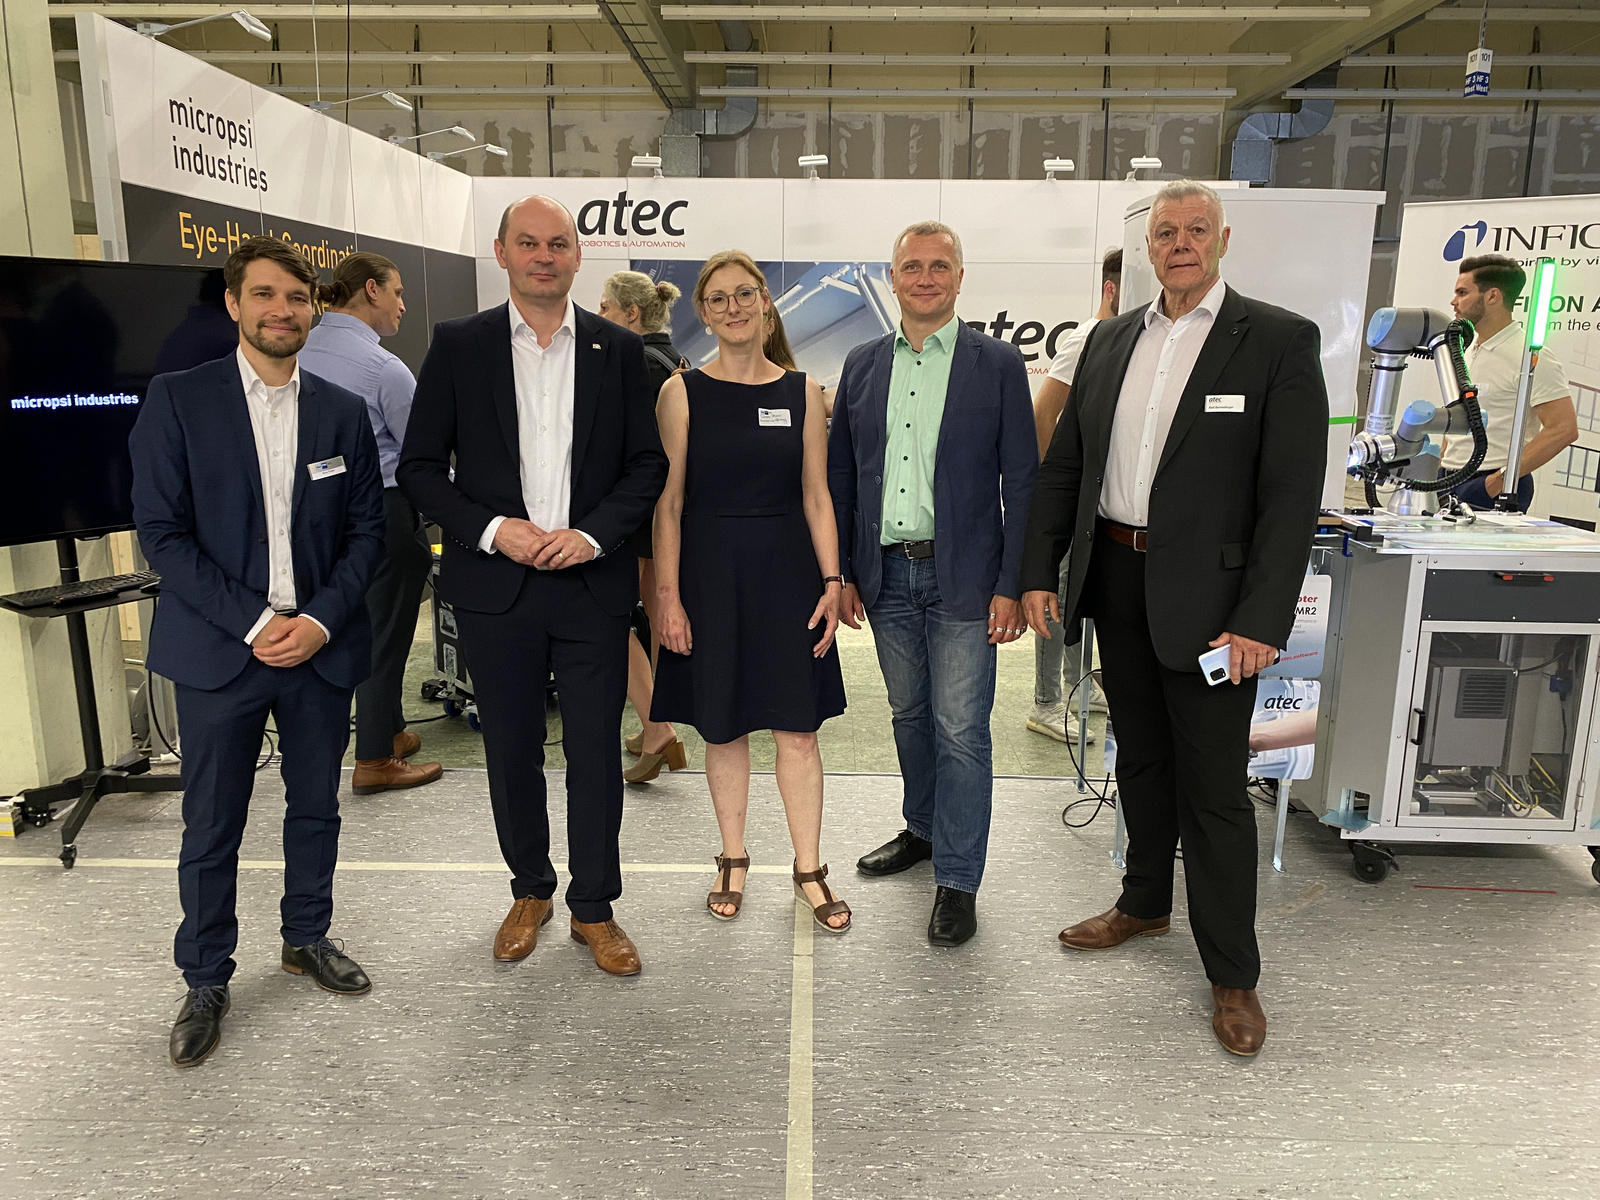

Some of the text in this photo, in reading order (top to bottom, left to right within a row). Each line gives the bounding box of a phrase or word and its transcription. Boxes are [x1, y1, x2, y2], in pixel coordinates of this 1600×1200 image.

[1481, 53, 1491, 62] 101
[1485, 76, 1490, 84] 3
[168, 97, 253, 150] micropsi
[172, 135, 268, 192] industries
[577, 190, 689, 237] atec
[578, 240, 620, 248] ROBOTICS
[622, 240, 628, 248] &
[1561, 257, 1582, 268] by
[1567, 318, 1591, 331] the
[11, 392, 139, 410] micropsi industries
[1296, 606, 1317, 615] MR2
[1264, 694, 1303, 710] atec
